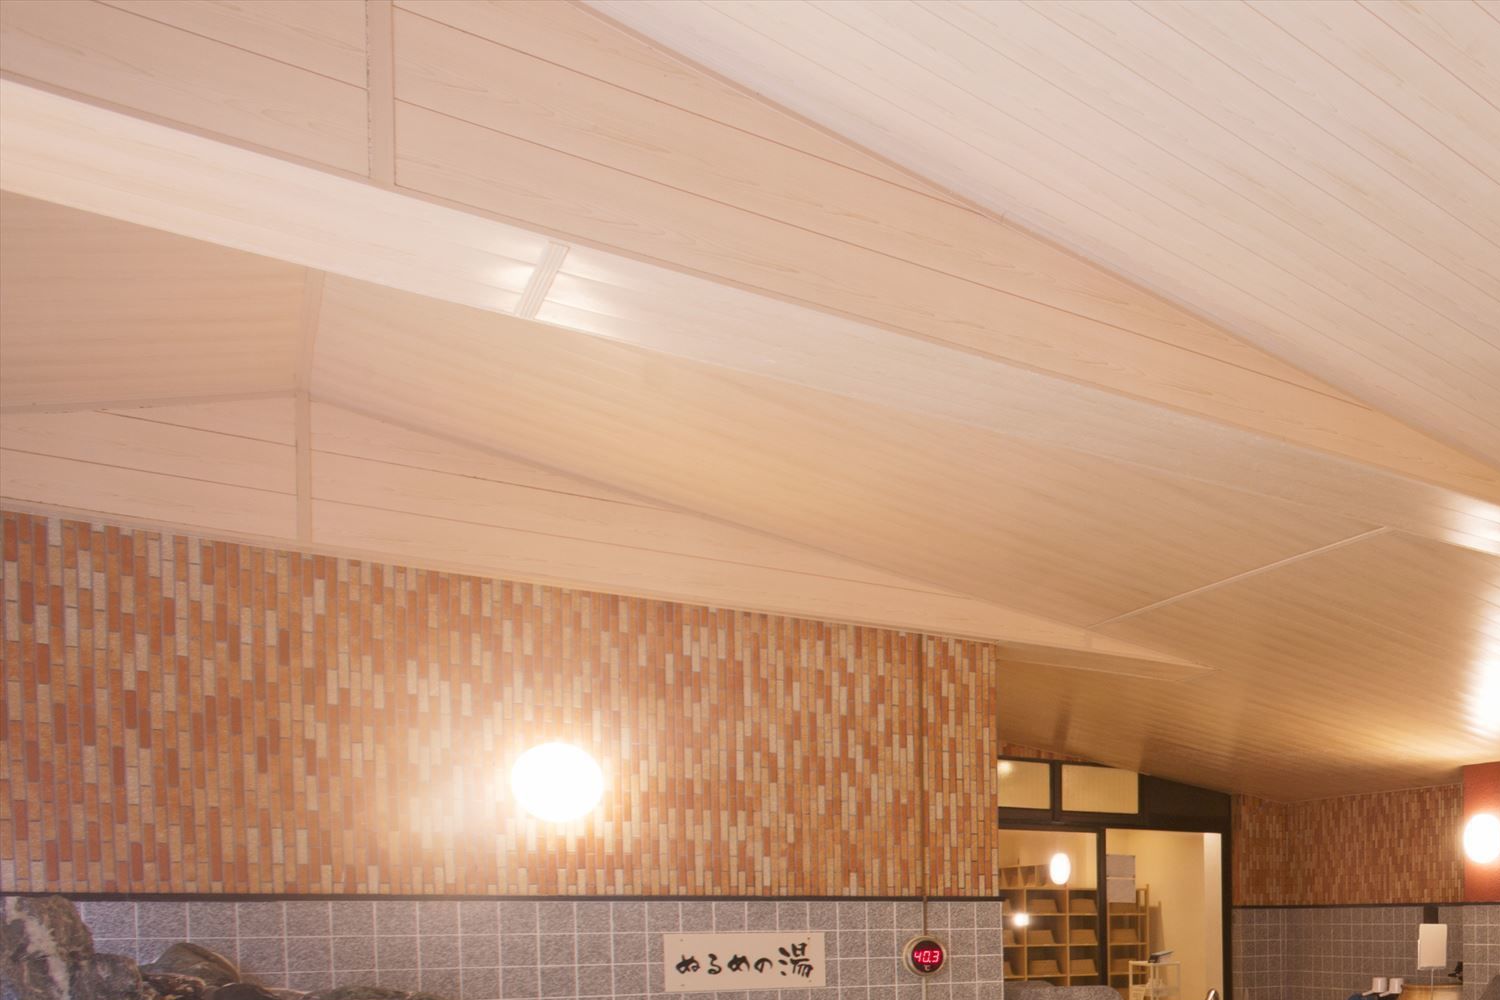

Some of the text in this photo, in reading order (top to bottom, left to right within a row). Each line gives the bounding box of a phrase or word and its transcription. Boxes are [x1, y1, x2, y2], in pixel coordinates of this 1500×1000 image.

[675, 942, 814, 978] ぬるめの湯
[913, 950, 941, 963] 40.3
